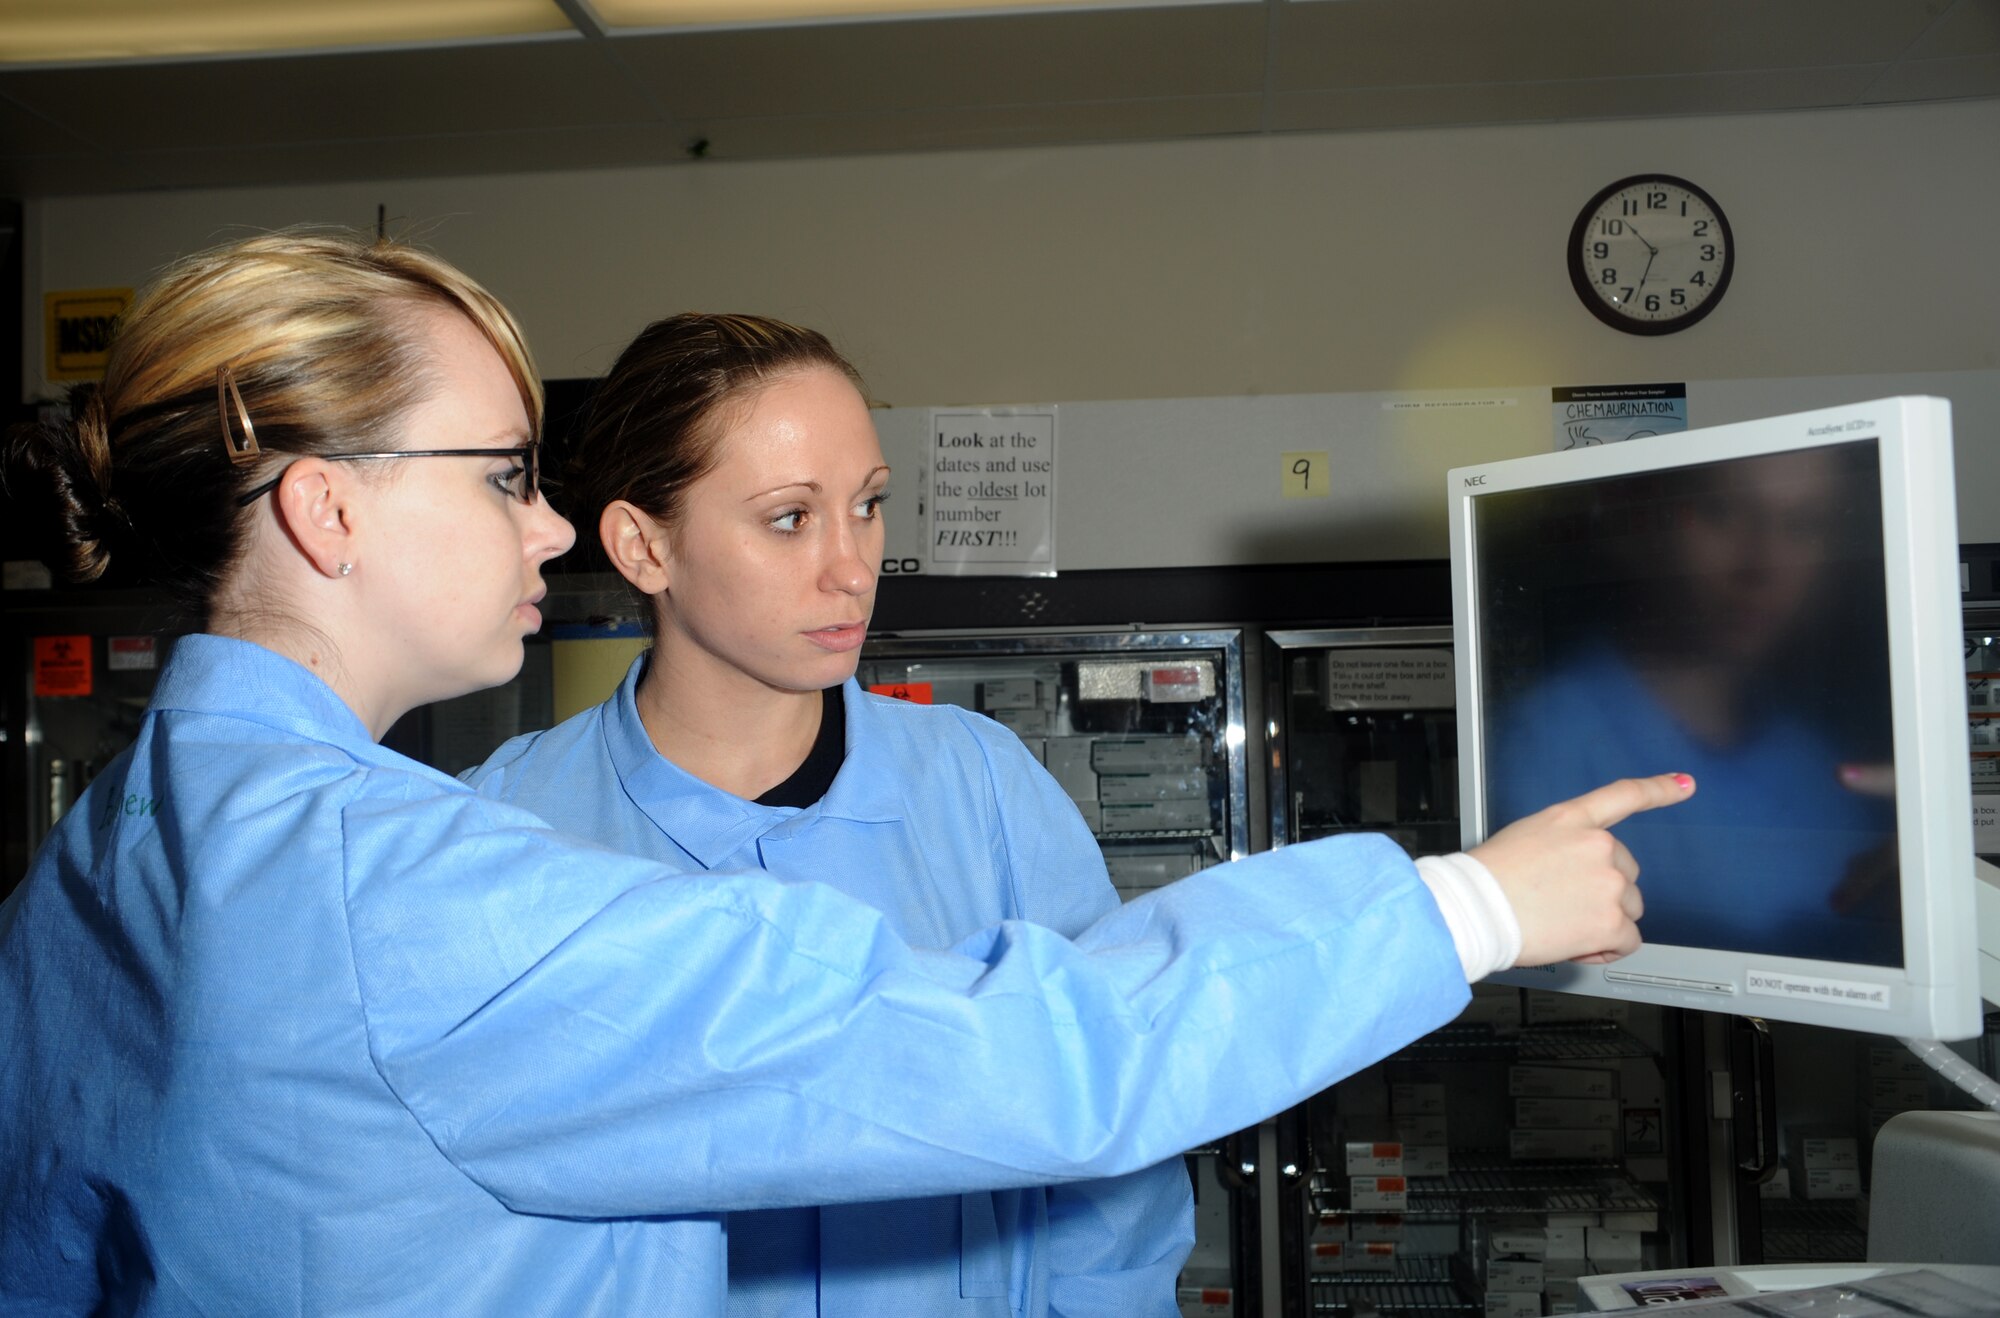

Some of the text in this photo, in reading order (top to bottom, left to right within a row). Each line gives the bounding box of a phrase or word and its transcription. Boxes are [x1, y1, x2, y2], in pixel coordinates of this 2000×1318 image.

[1623, 199, 1637, 216] 11
[1647, 192, 1667, 209] 12
[1681, 201, 1686, 216] 1
[1601, 218, 1622, 236] 10
[1693, 220, 1708, 237] 2
[1594, 242, 1609, 259] 9
[1700, 244, 1715, 261] 3
[1602, 268, 1617, 285] 8
[1690, 271, 1706, 287] 4
[1620, 287, 1634, 303] 7
[1645, 294, 1660, 312] 6
[1670, 289, 1686, 305] 5
[1566, 401, 1674, 419] CHEMAURINATION
[937, 432, 1037, 448] Look at the
[936, 457, 1050, 473] dates and use
[1292, 458, 1310, 490] 9
[1464, 474, 1487, 488] NEC
[936, 481, 1046, 498] the oldest lot
[936, 507, 1001, 522] number
[936, 531, 1017, 546] FIRST!!!
[1433, 672, 1446, 680] put
[1750, 977, 1763, 987] DO
[1765, 979, 1782, 990] NOT
[1784, 982, 1810, 993] operate
[1813, 986, 1829, 995] with
[1832, 987, 1843, 997] the
[1846, 989, 1867, 999] alarm
